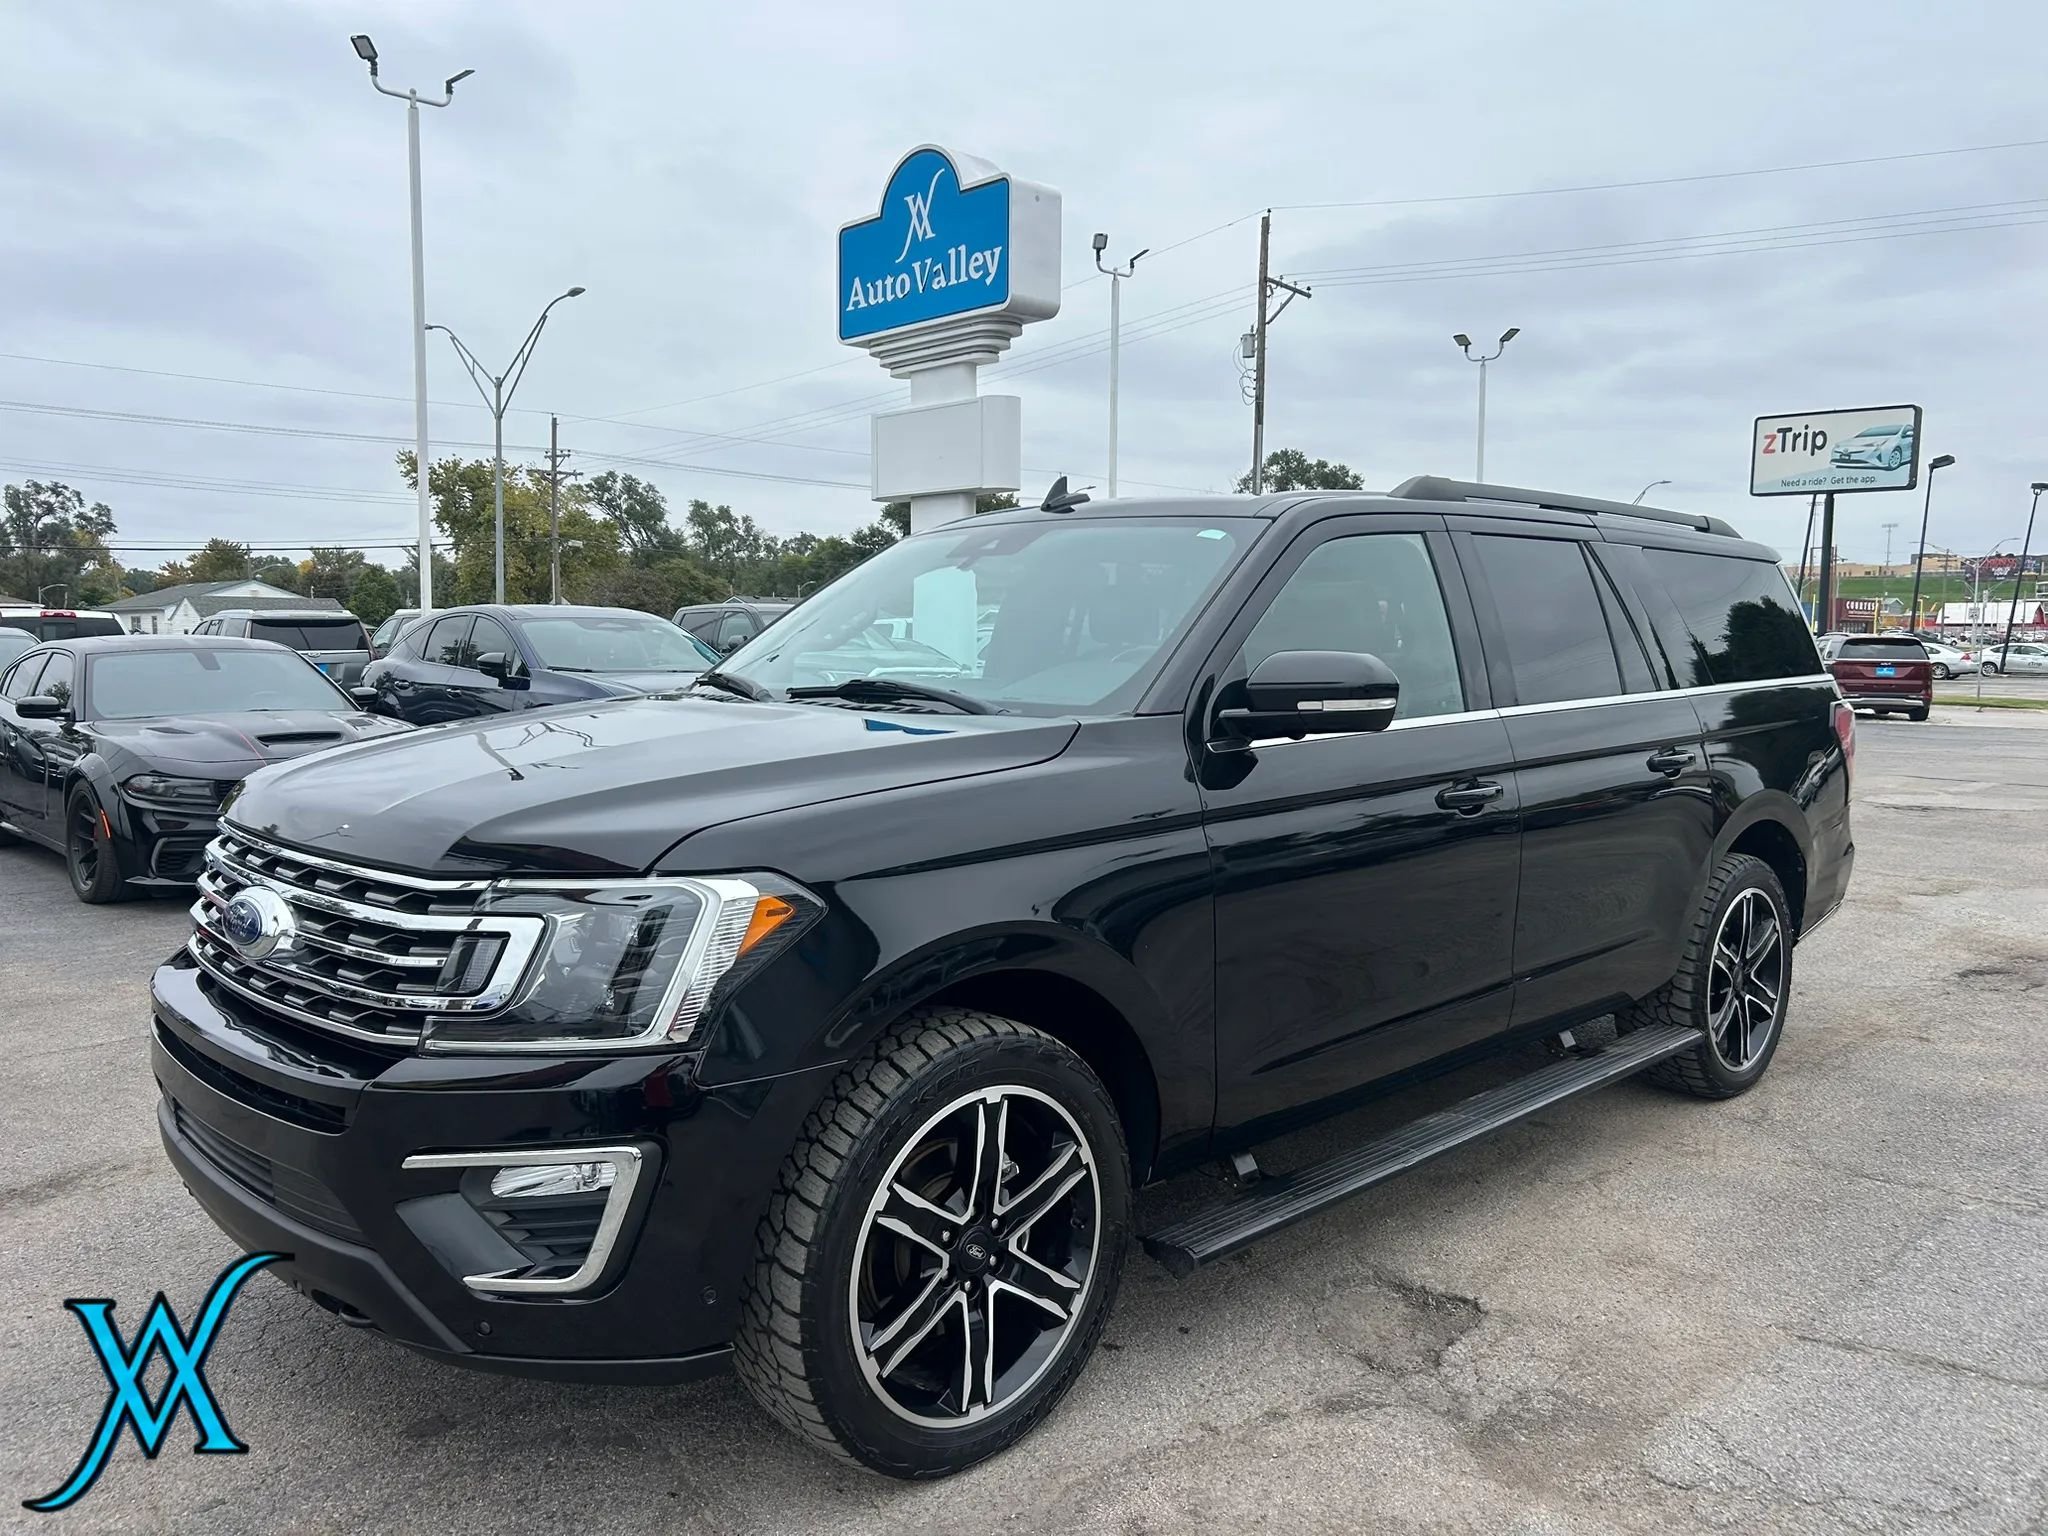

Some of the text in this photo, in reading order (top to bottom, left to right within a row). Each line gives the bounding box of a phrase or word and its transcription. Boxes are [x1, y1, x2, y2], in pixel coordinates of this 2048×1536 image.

[1763, 424, 1828, 456] zTrip
[1780, 478, 1800, 487] Need
[1808, 477, 1827, 486] ride?
[1830, 476, 1844, 485] Get
[1846, 476, 1859, 484] the
[1860, 475, 1878, 485] app.
